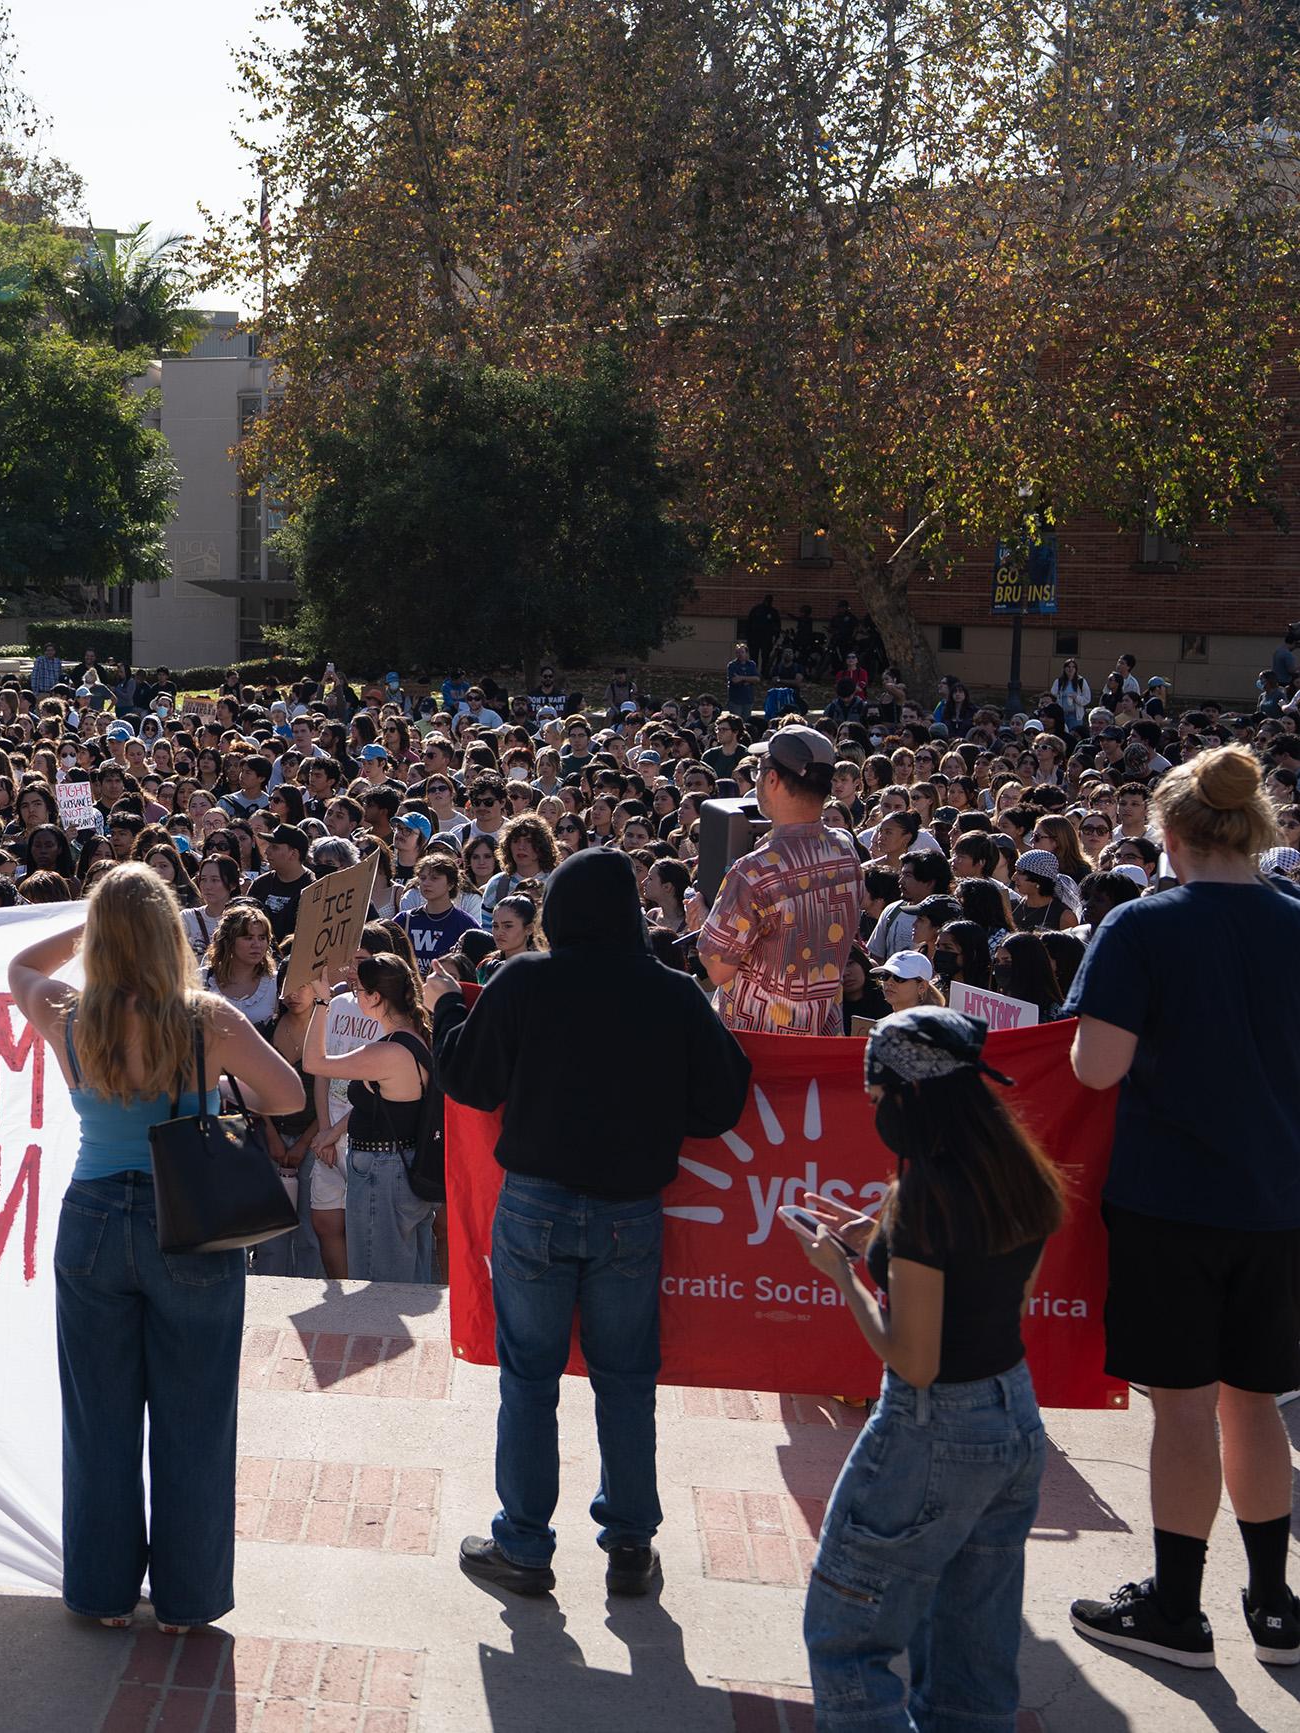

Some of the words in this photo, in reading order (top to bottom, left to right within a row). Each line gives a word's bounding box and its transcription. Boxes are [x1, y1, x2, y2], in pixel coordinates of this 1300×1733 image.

[996, 567, 1019, 585] GO
[58, 782, 89, 798] FIGHT
[323, 888, 355, 924] ICE
[314, 918, 351, 957] OUT
[964, 991, 1022, 1030] HISTORY
[661, 1273, 744, 1300] cratic
[1028, 1291, 1088, 1319] rica
